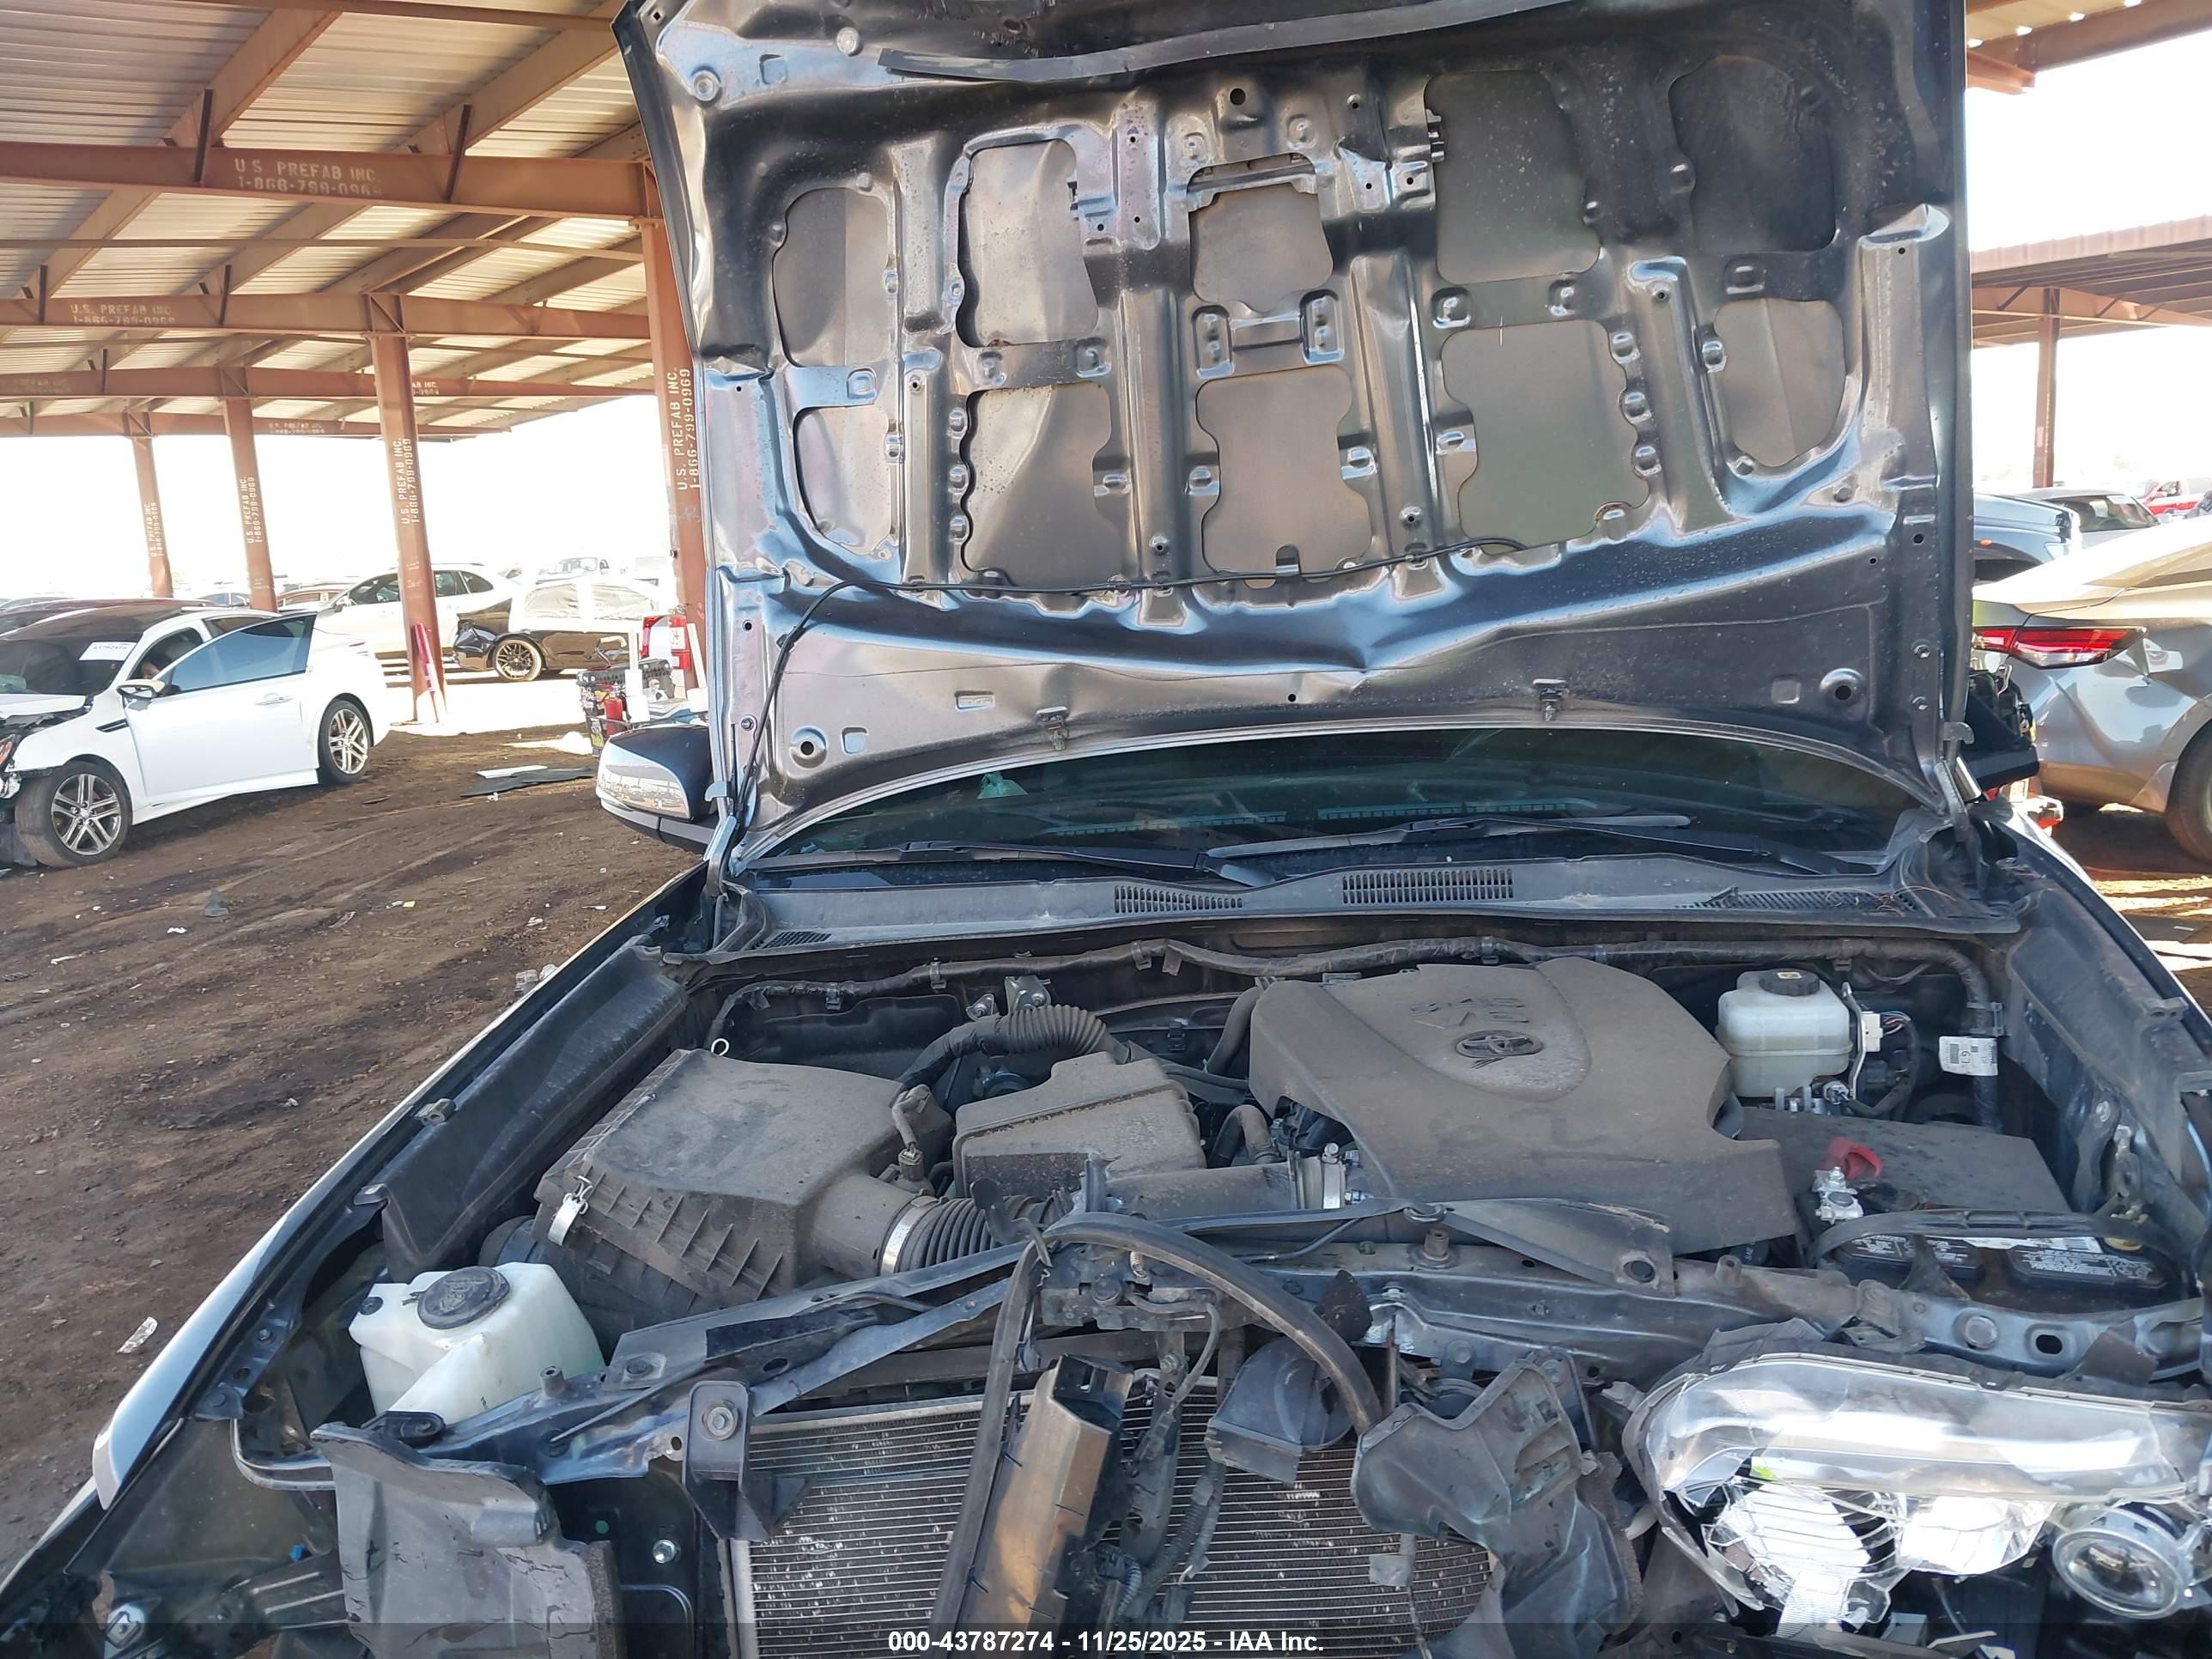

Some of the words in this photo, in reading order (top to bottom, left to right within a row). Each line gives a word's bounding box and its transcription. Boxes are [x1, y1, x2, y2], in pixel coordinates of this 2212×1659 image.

[276, 161, 342, 180] PREFAB
[100, 304, 147, 315] PREFAB
[666, 367, 679, 394] INC.
[670, 402, 684, 456] PREFAB
[679, 368, 701, 489] 1-866-799-0969
[392, 438, 403, 457] INC.
[395, 462, 407, 500] PREFAB
[676, 464, 688, 490] U.S.
[400, 505, 410, 524] U.S.
